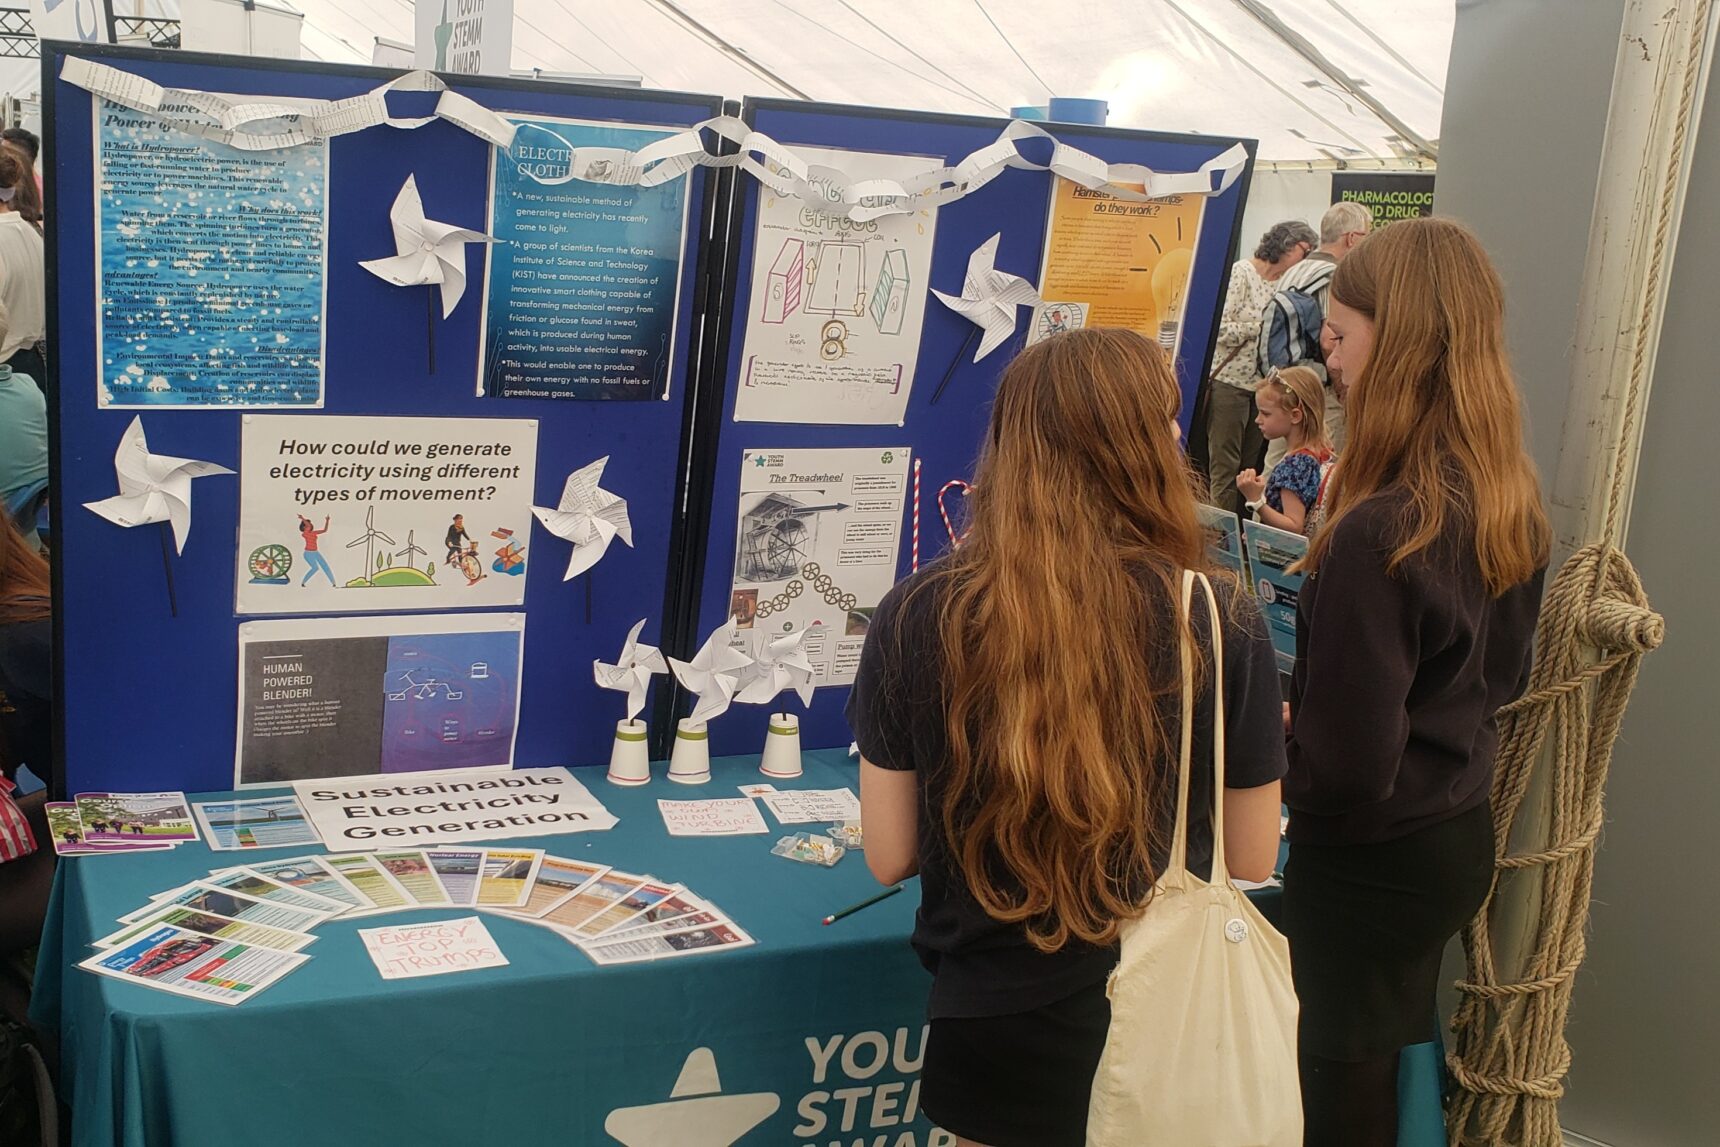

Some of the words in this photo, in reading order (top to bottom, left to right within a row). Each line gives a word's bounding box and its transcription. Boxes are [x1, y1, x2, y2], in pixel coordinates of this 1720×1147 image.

[454, 16, 482, 49] STEMM
[452, 50, 480, 74] AWARD
[104, 115, 156, 128] Power
[519, 145, 573, 162] ELECTR
[517, 163, 566, 177] CLOTH
[546, 194, 590, 204] sustainable
[593, 197, 621, 206] method
[516, 208, 560, 219] generating
[562, 211, 600, 221] electricity
[618, 214, 648, 224] recently
[1094, 202, 1106, 212] do
[1108, 202, 1128, 215] they
[1130, 206, 1152, 215] work
[1370, 204, 1383, 217] ND
[1386, 206, 1420, 218] DRUG
[549, 224, 568, 234] light.
[523, 242, 547, 252] group
[560, 243, 593, 252] scientists
[596, 245, 614, 254] from
[616, 246, 628, 255] the
[630, 247, 653, 256] Korea
[513, 256, 543, 265] Institute
[557, 258, 585, 267] Science
[606, 260, 648, 271] Technology
[512, 270, 535, 279] (KIST)
[538, 272, 556, 280] have
[559, 273, 600, 282] announced
[603, 275, 615, 283] the
[617, 275, 648, 285] creation
[511, 284, 551, 294] innovative
[554, 287, 575, 296] smart
[578, 288, 606, 299] clothing
[609, 289, 640, 299] capable
[510, 300, 559, 310] transforming
[562, 302, 604, 311] mechanical
[607, 305, 634, 314] energy
[636, 304, 653, 313] from
[509, 313, 536, 322] friction
[550, 316, 578, 326] glucose
[581, 316, 602, 325] found
[605, 317, 612, 325] in
[614, 319, 638, 328] sweat,
[508, 329, 530, 337] which
[541, 330, 578, 340] produced
[580, 331, 604, 341] during
[508, 343, 537, 353] activity,
[556, 345, 582, 353] usable
[584, 346, 618, 354] electrical
[621, 348, 648, 356] energy.
[507, 360, 521, 368] This
[524, 360, 546, 369] would
[549, 361, 576, 370] enable
[604, 363, 635, 372] produce
[544, 377, 571, 385] energy
[602, 376, 620, 385] fossil
[623, 377, 640, 386] fuels
[504, 389, 549, 398] greenhouse
[279, 439, 326, 456] How
[331, 440, 390, 456] could
[394, 443, 422, 456] we
[426, 442, 512, 459] generate
[270, 463, 375, 482] electricity
[379, 464, 432, 482] using
[437, 464, 520, 479] different
[769, 474, 787, 483] The
[790, 473, 844, 482] Treadwheel
[294, 487, 350, 505] types
[356, 486, 377, 501] of
[380, 486, 496, 501] movement?
[264, 663, 302, 674] HUMAN
[264, 676, 312, 687] POWERED
[264, 688, 312, 700] BLENDER!
[311, 774, 564, 801] Sustainable
[342, 793, 560, 819] Electricity
[708, 799, 747, 809] YOUR
[343, 811, 589, 839] Generation
[378, 925, 469, 945] ENERGY
[400, 939, 454, 955] TOP
[390, 947, 496, 974] TRUMPS
[805, 1024, 930, 1084] YOU
[792, 1079, 922, 1138] STE
